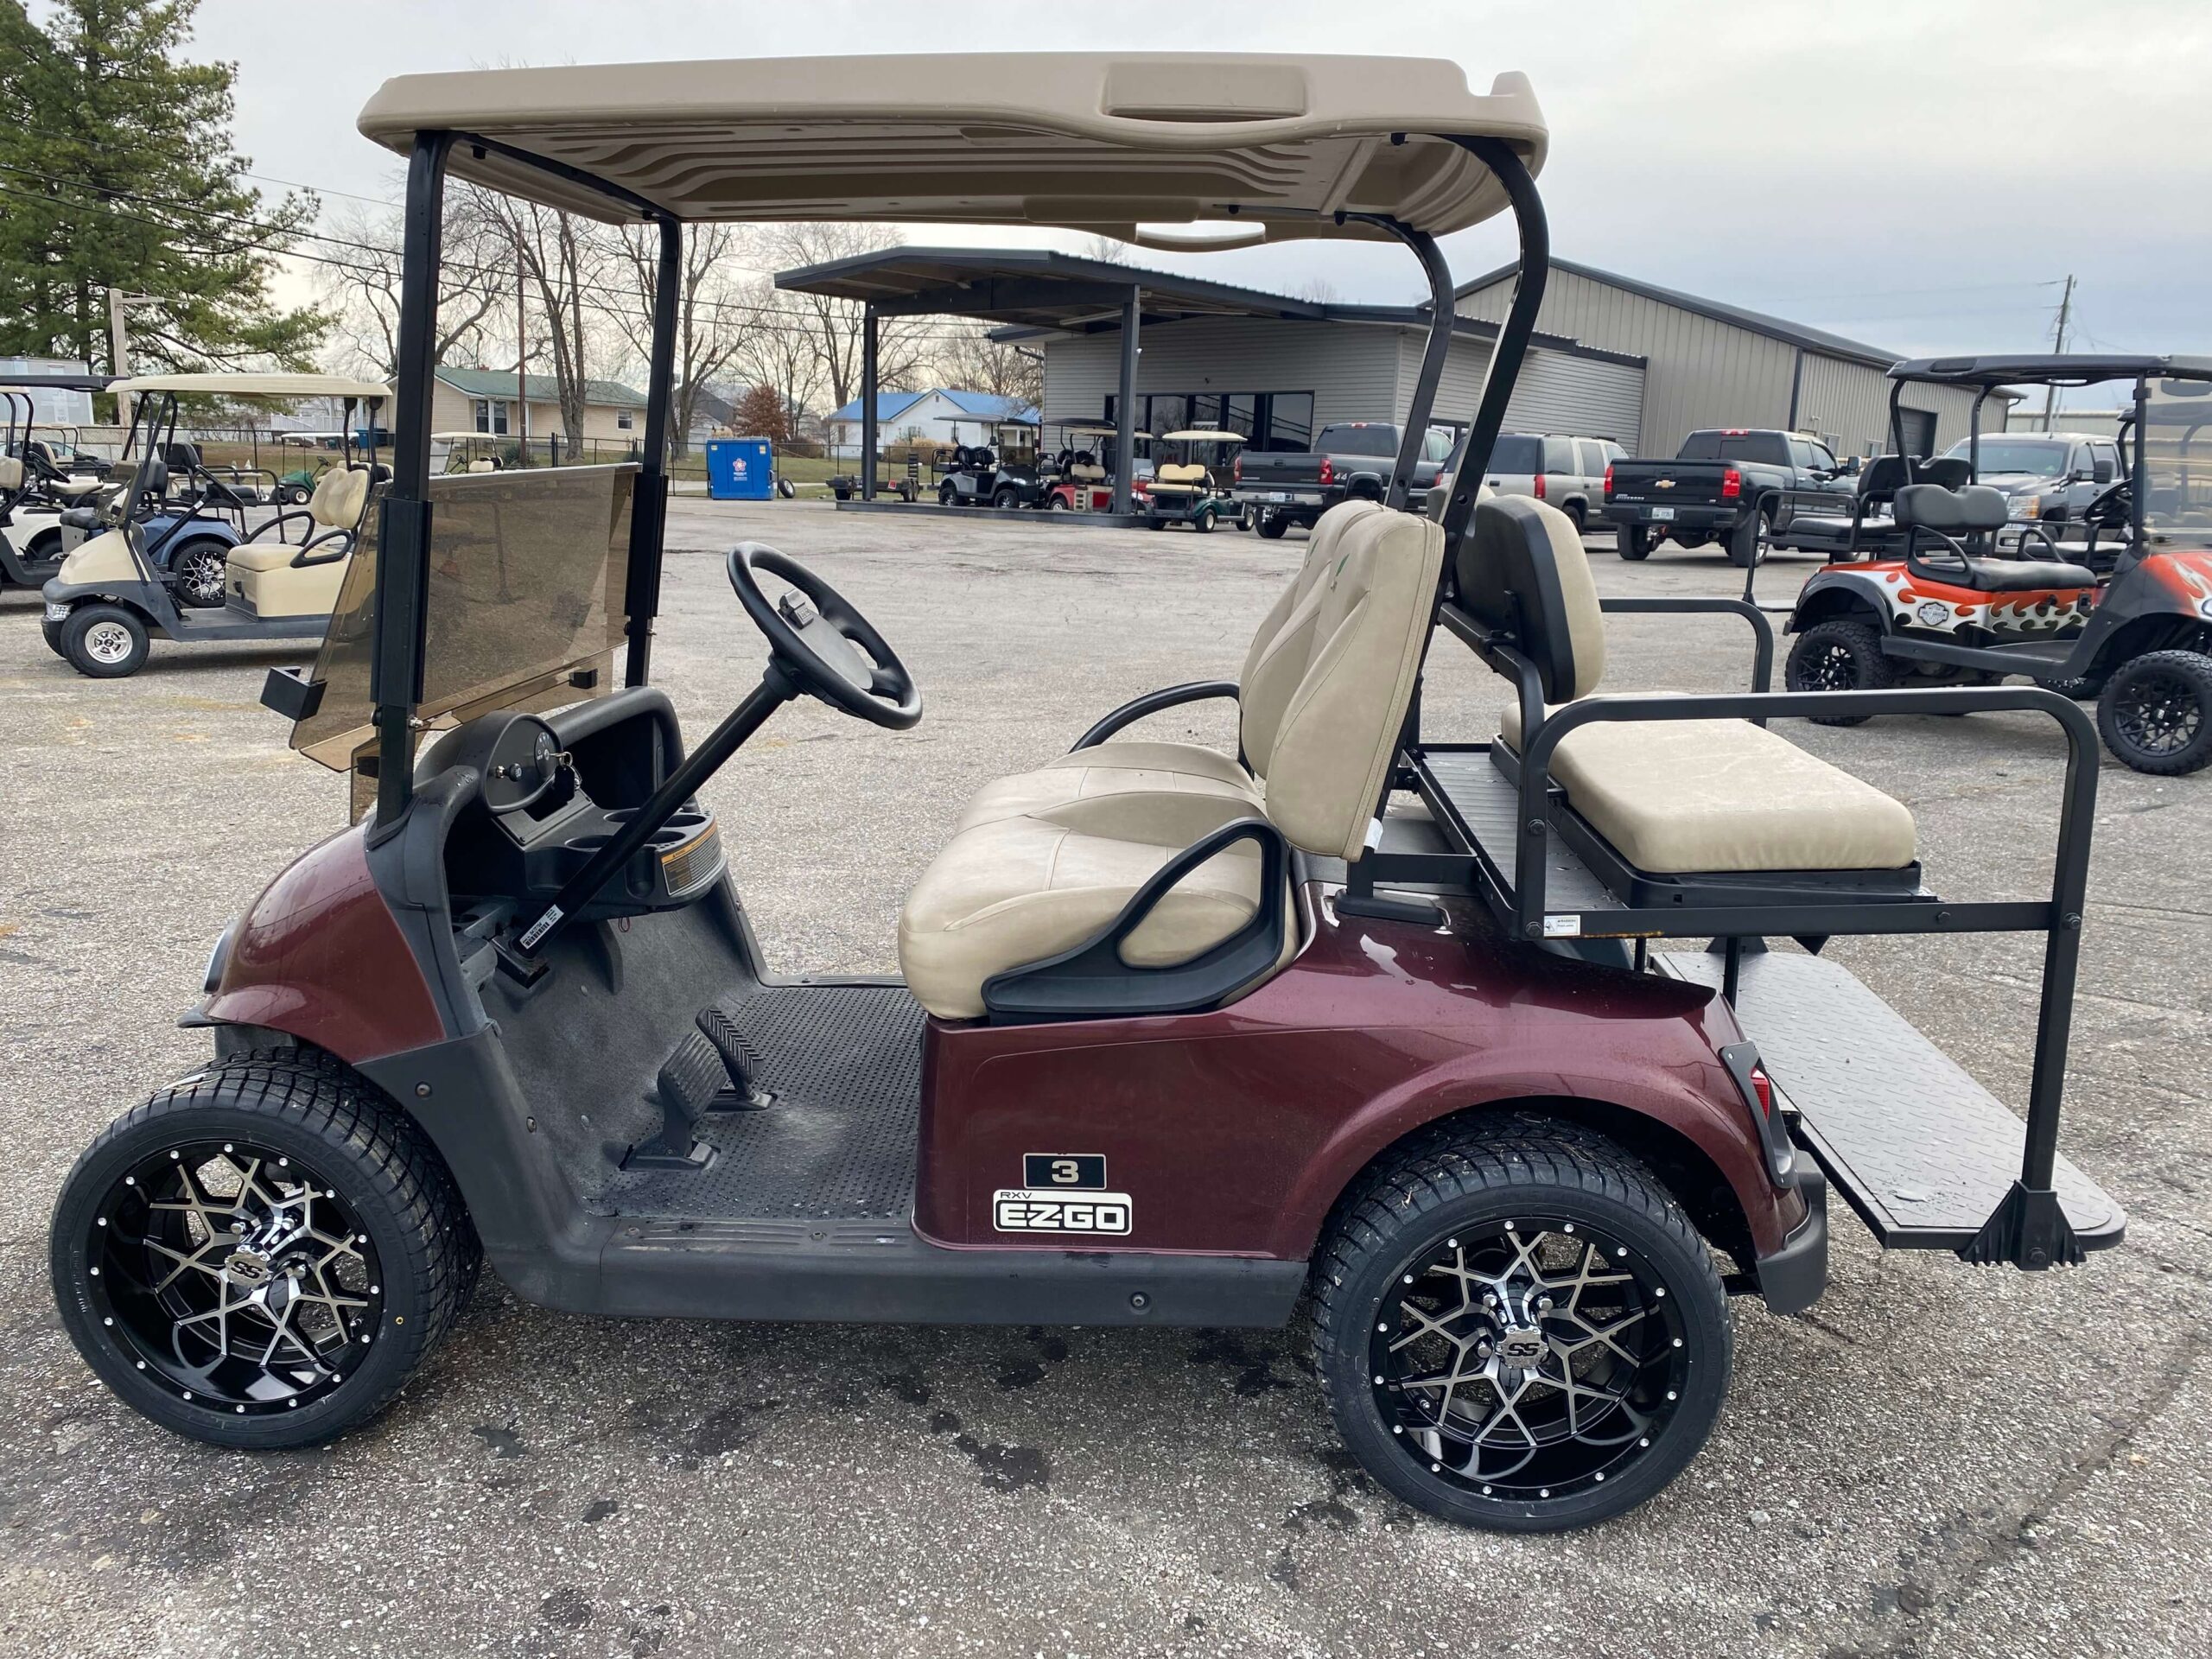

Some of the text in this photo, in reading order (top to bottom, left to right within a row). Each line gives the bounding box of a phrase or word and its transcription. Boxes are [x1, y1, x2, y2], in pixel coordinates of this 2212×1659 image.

[1052, 1160, 1079, 1183] 3
[231, 1261, 263, 1279] SS
[1507, 1343, 1540, 1357] SS
